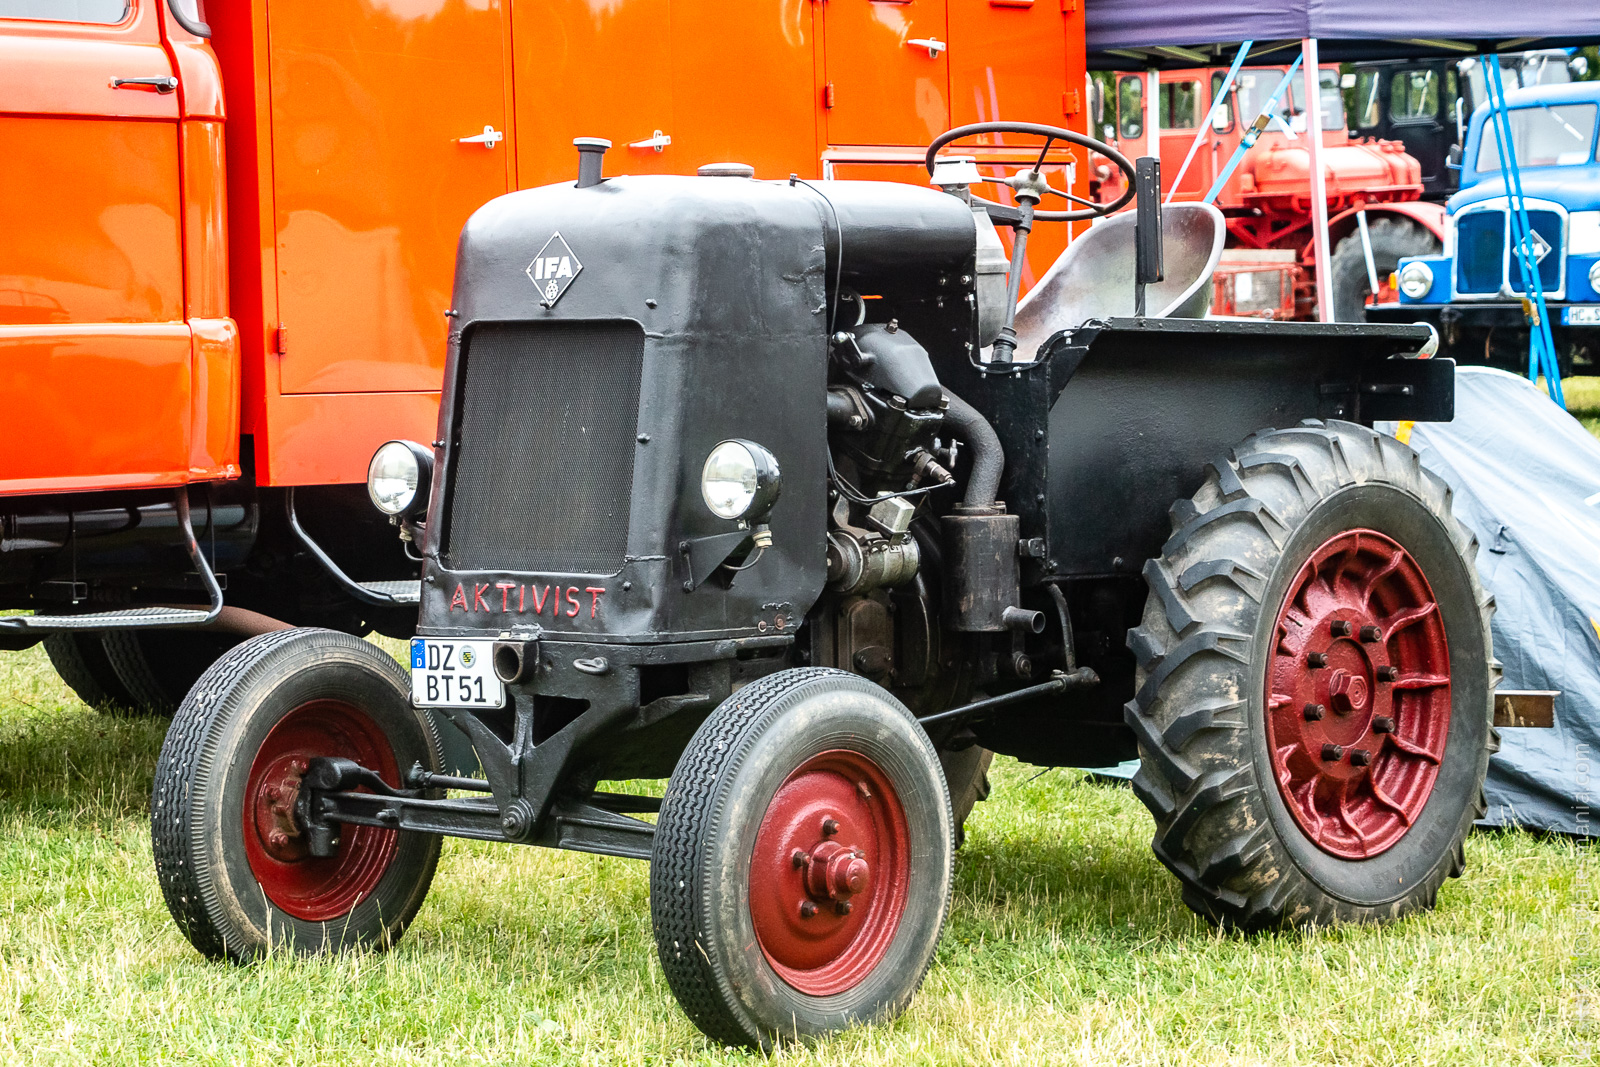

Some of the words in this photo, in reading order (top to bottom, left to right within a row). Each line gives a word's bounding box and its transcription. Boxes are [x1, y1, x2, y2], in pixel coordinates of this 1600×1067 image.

[535, 256, 573, 280] IFA
[450, 583, 606, 619] AKTIVIST
[416, 658, 423, 668] D
[428, 644, 455, 671] DZ
[427, 675, 454, 702] BT
[459, 675, 486, 703] 51
